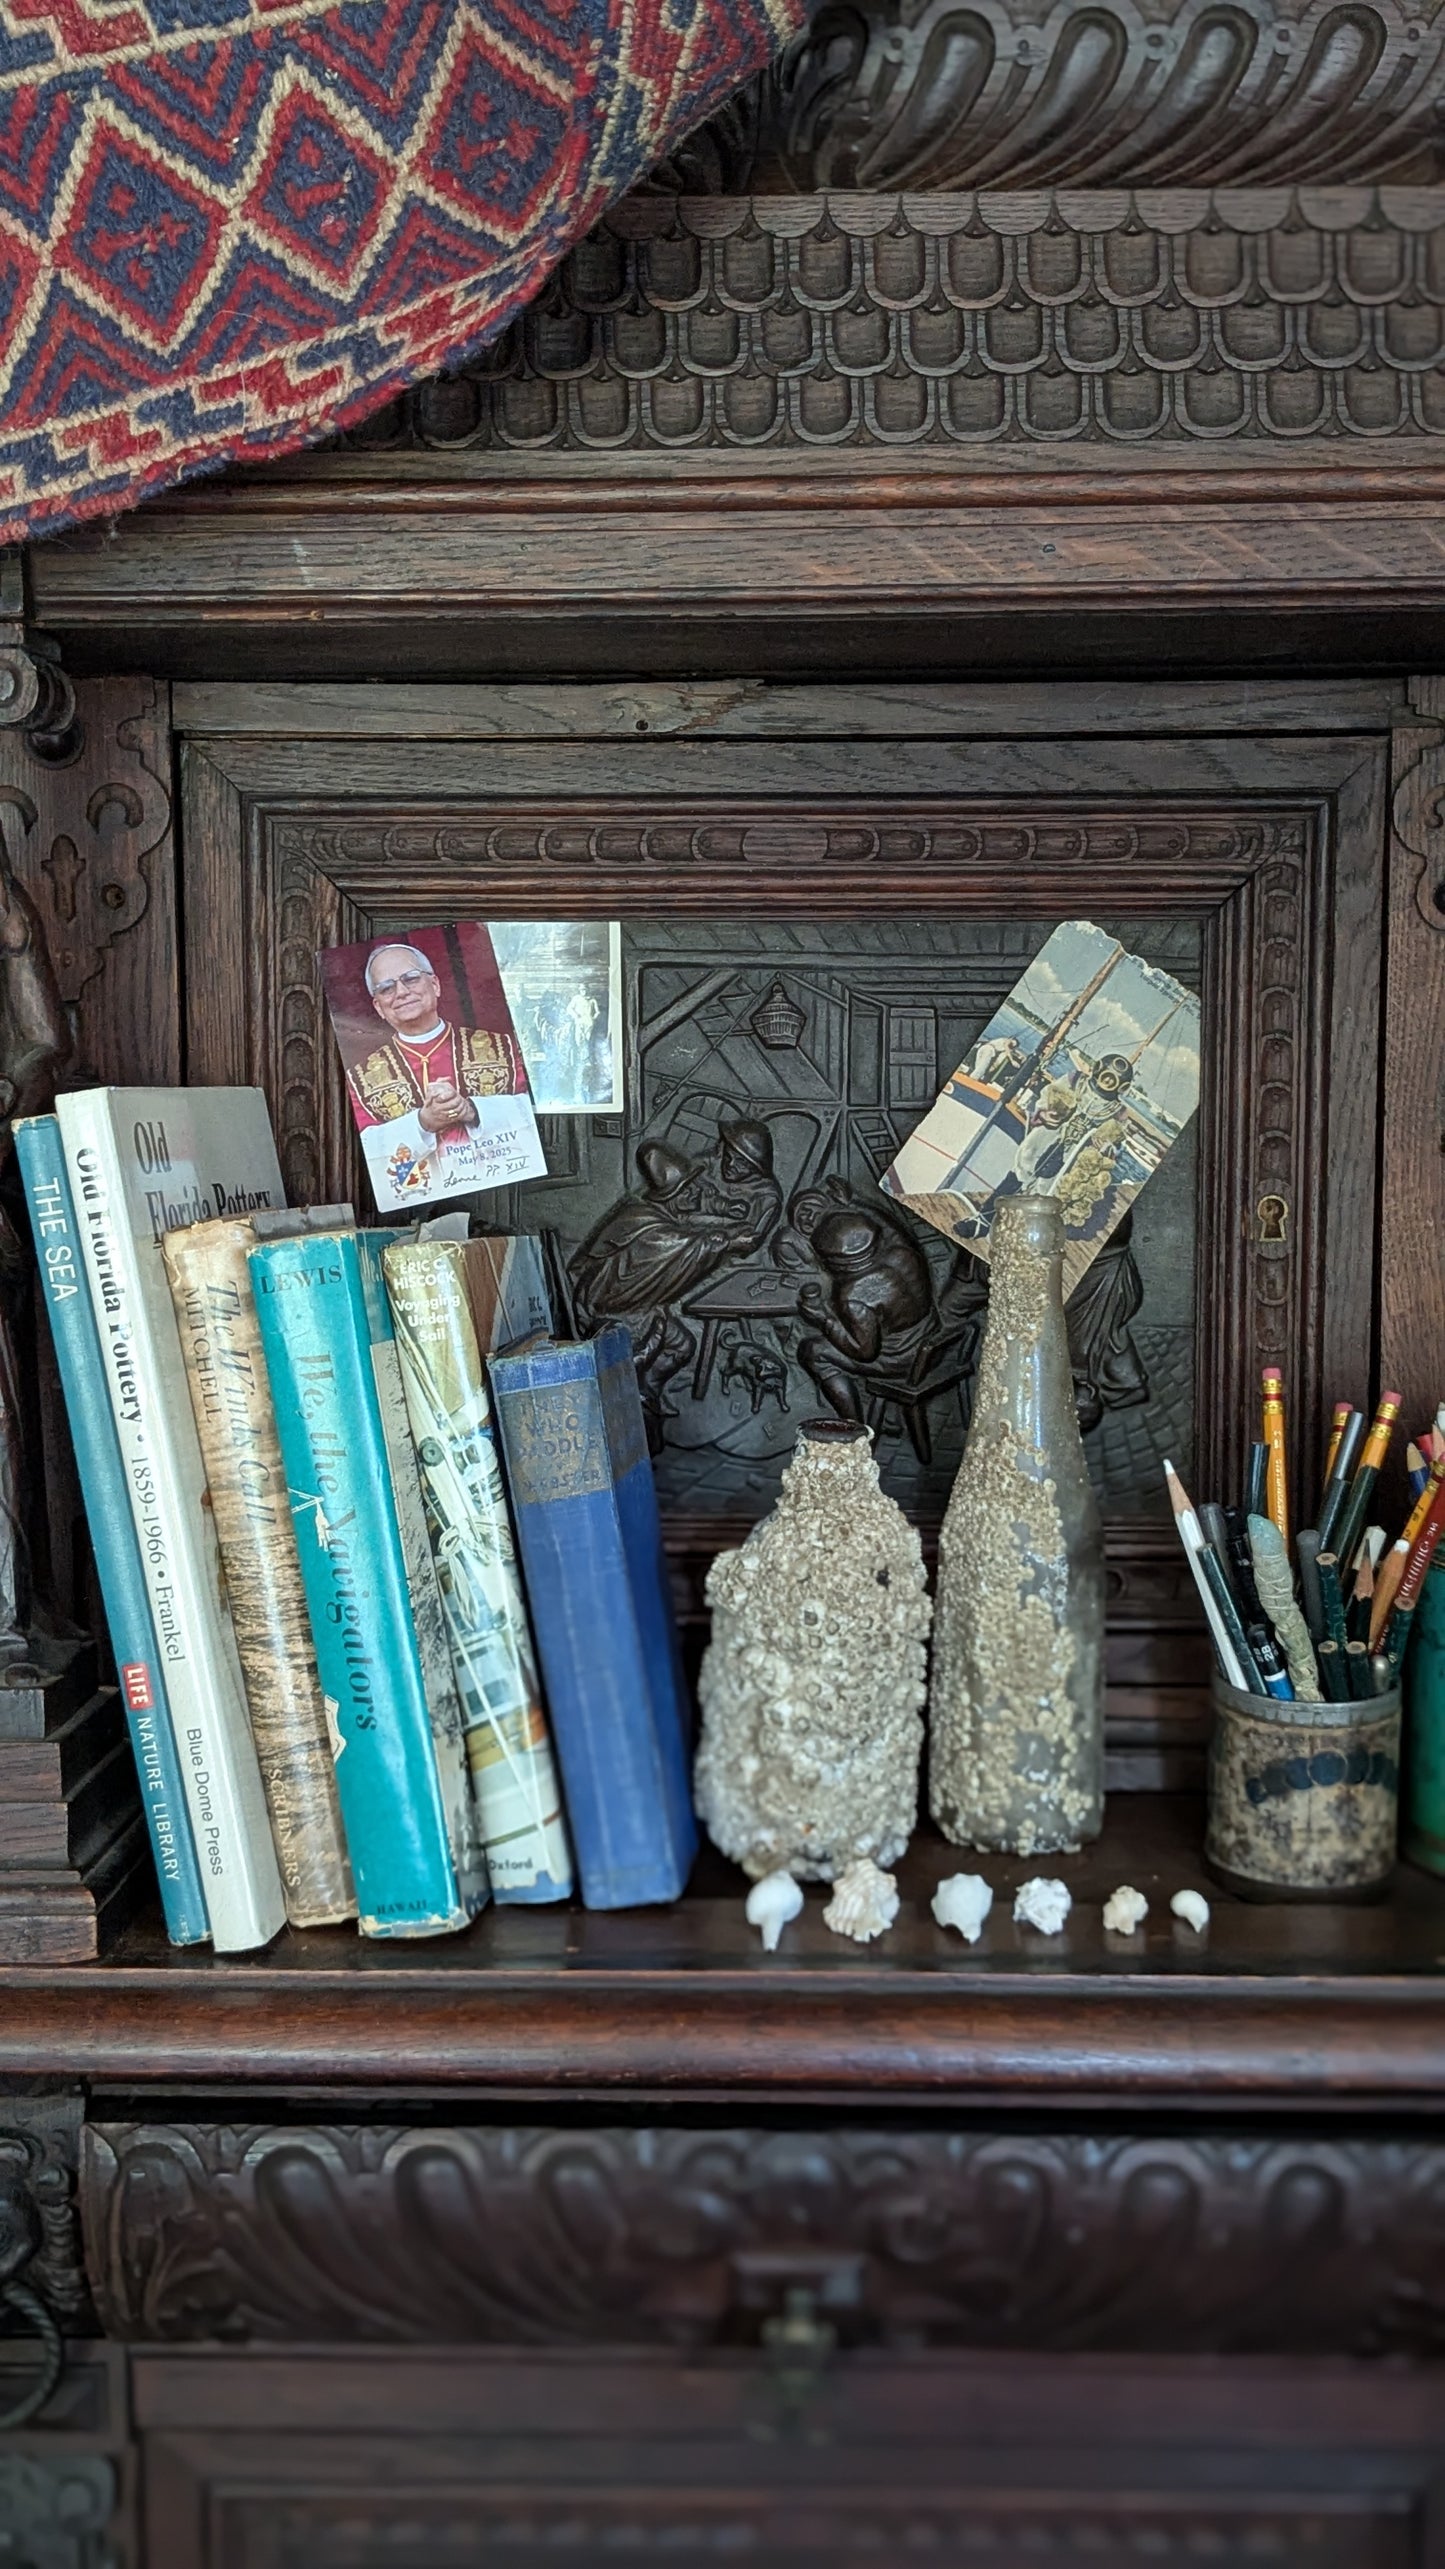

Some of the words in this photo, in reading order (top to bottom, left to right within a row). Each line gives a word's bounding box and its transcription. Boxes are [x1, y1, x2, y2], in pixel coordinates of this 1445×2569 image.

[134, 1122, 172, 1174] Old
[446, 1144, 471, 1155] Pope
[474, 1140, 493, 1149] Leo
[496, 1131, 517, 1144] XIV
[458, 1156, 478, 1166] May
[491, 1147, 511, 1159] 2025
[505, 1156, 529, 1174] XIV
[76, 1147, 101, 1201] Old
[32, 1177, 67, 1238] THE
[145, 1185, 212, 1244] Florida
[212, 1183, 270, 1216] Pottery
[45, 1243, 78, 1303] SEA
[86, 1208, 123, 1317] Florida
[261, 1265, 342, 1295] LEWIS
[393, 1270, 457, 1290] HISCOCK
[400, 1259, 430, 1275] ERIC
[433, 1257, 447, 1271] C.
[206, 1280, 241, 1338] The
[395, 1294, 460, 1312] Voyaging
[408, 1312, 451, 1327] Under
[183, 1286, 222, 1424] MITCHELL
[419, 1326, 446, 1343] Sail
[109, 1319, 143, 1424] Pottery
[218, 1349, 262, 1452] Winds
[296, 1351, 337, 1421] We,
[522, 1413, 580, 1436] WHO
[239, 1459, 276, 1525] Call
[310, 1432, 348, 1494] the
[131, 1457, 168, 1564] 1859-1966
[155, 1583, 187, 1662] Frankel
[324, 1507, 378, 1732] Navigators
[1261, 1644, 1275, 1661] 2B
[126, 1667, 149, 1705] LIFE
[137, 1717, 164, 1791] NATURE
[186, 1727, 204, 1766] Blue
[195, 1771, 213, 1822] Dome
[204, 1827, 223, 1876] Press
[269, 1768, 300, 1888] SCRIBNERS
[152, 1803, 180, 1881] LIBRARY
[489, 1856, 533, 1870] Oxford
[377, 1899, 427, 1914] HAWAII
